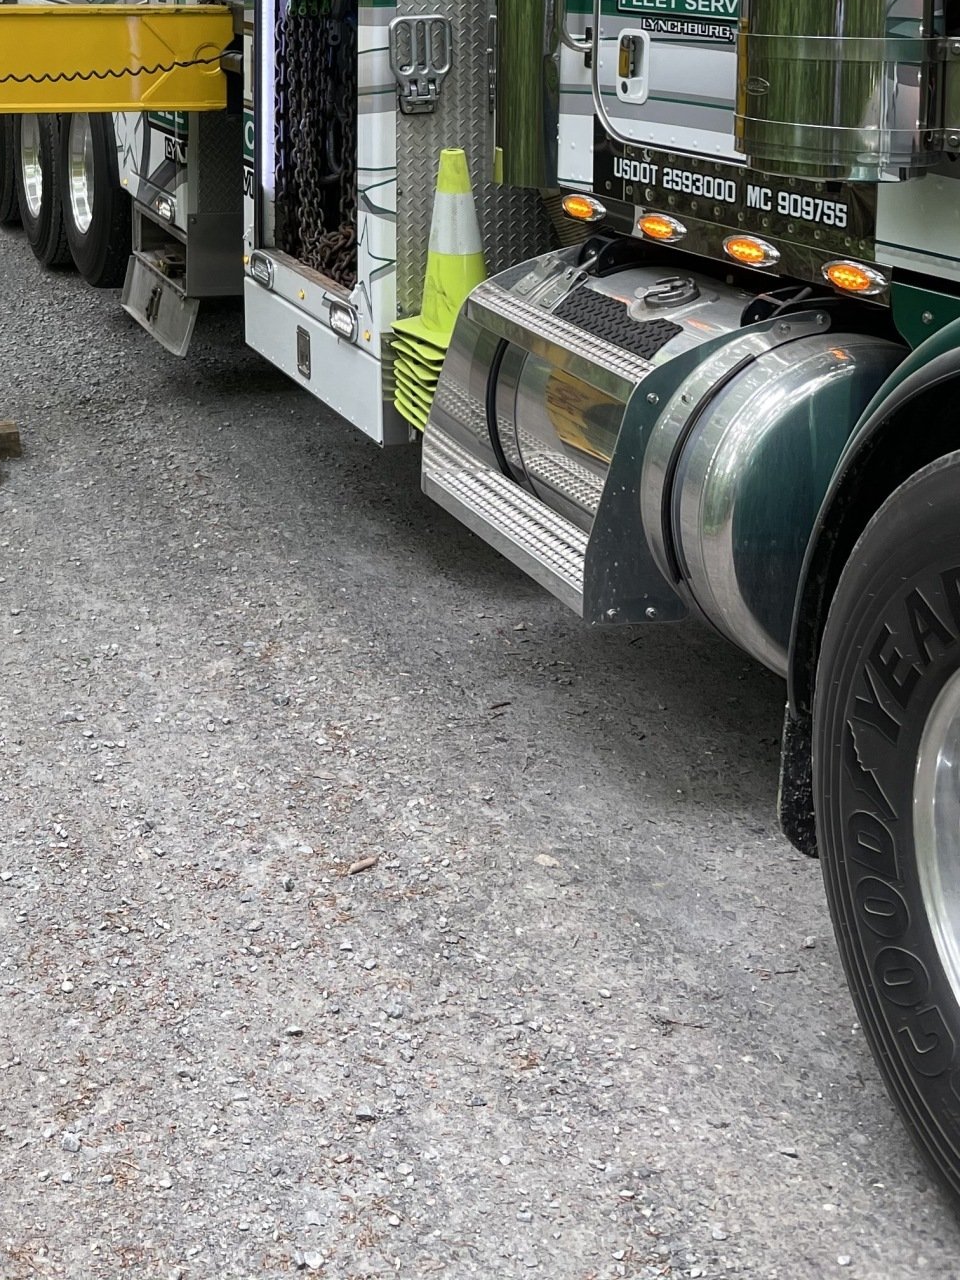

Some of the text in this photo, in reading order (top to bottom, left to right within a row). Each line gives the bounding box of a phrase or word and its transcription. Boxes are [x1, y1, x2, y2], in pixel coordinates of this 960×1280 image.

[642, 18, 734, 41] LYNCHBURG,
[613, 157, 848, 228] USDOT 2593000 MC 909755
